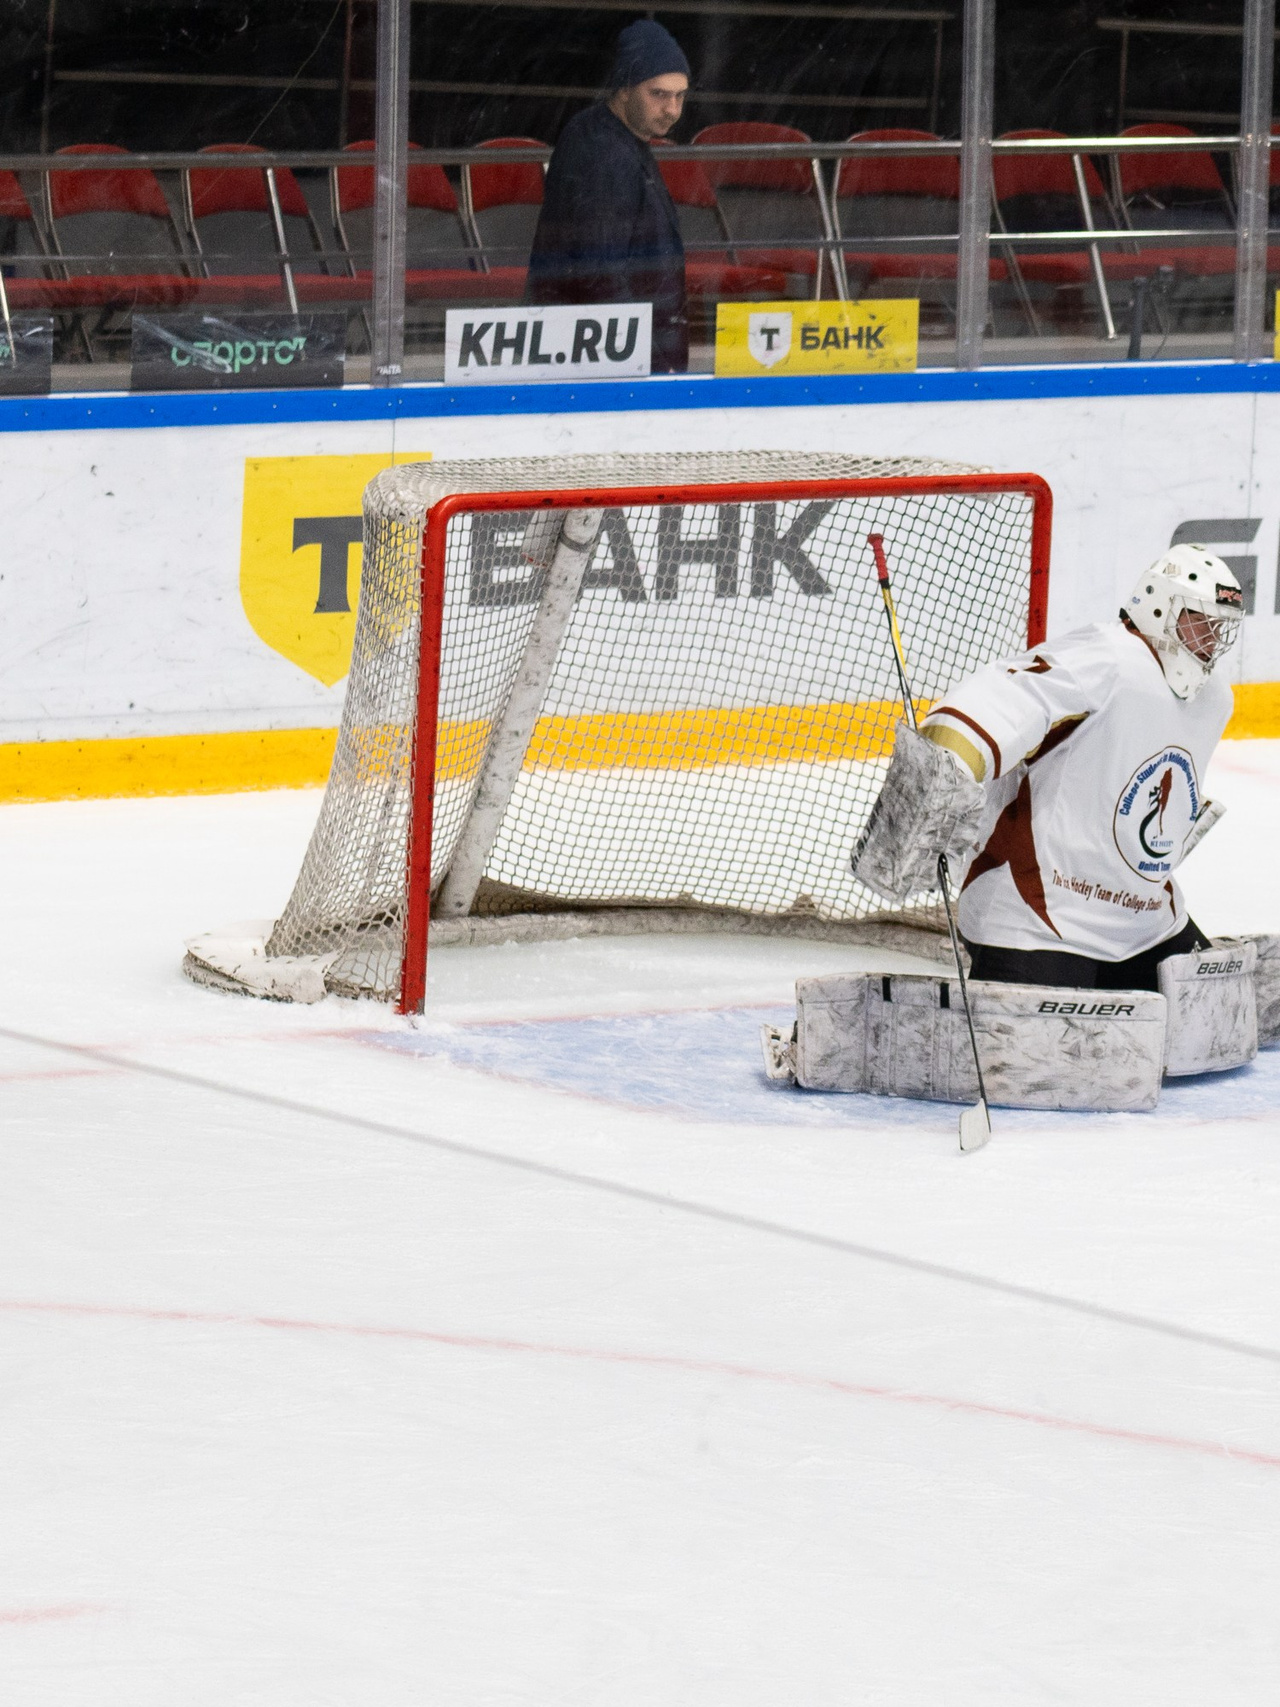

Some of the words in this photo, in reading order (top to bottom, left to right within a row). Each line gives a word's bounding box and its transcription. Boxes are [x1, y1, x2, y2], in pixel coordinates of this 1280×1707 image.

[457, 317, 640, 367] KHL.RU
[801, 326, 884, 350] БАНК
[1094, 883, 1113, 903] Team
[1113, 890, 1124, 906] of
